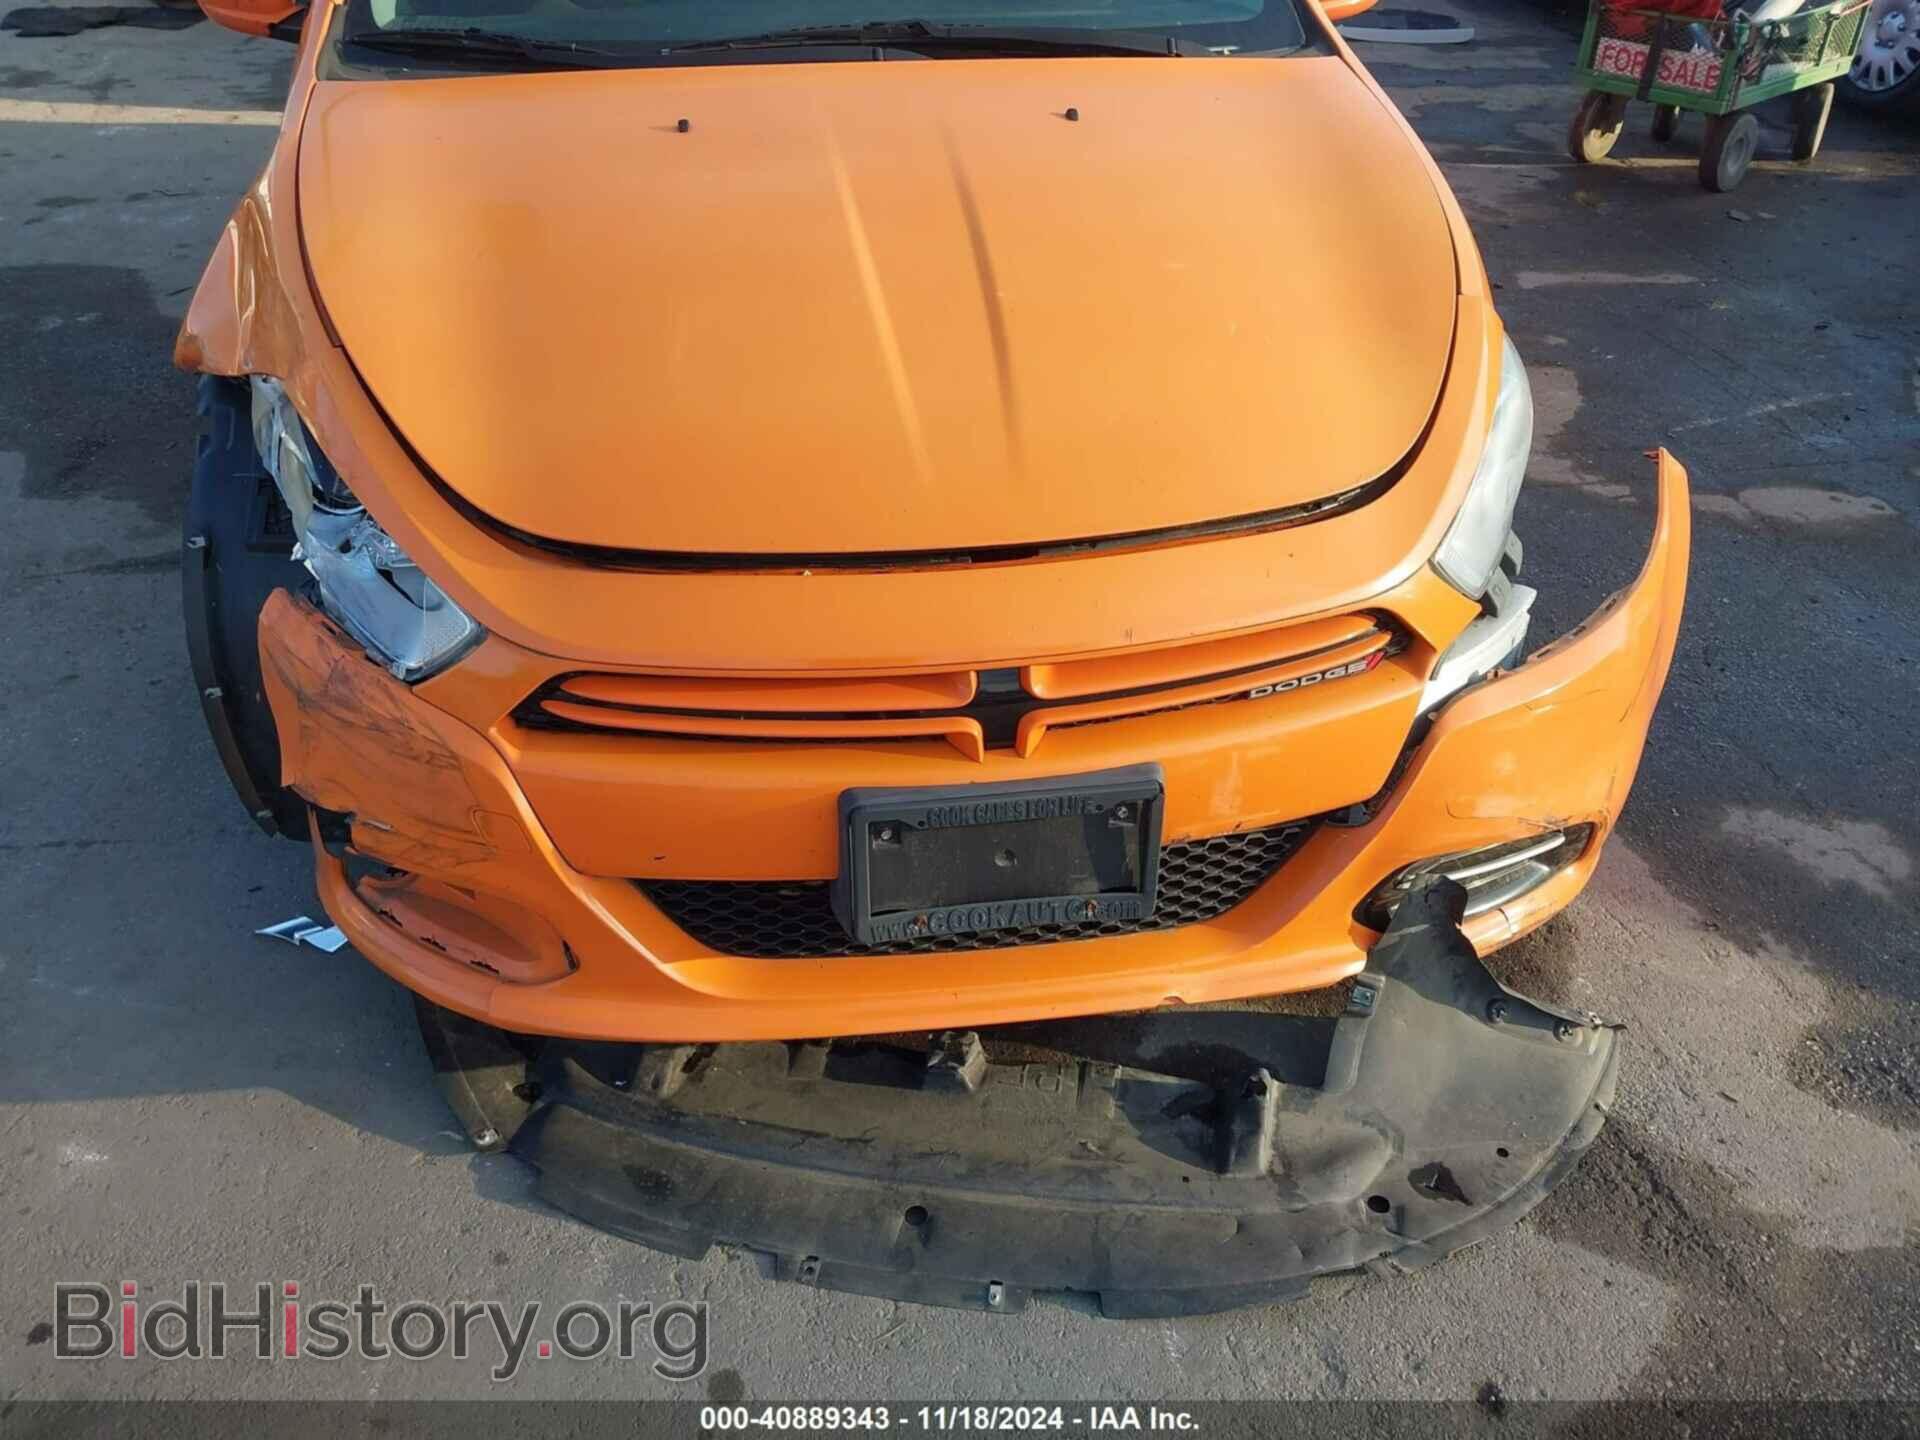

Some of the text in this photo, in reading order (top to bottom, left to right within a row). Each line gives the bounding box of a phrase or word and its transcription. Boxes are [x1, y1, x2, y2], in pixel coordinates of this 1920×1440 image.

[1601, 43, 1720, 90] FOR SALE
[1249, 659, 1368, 699] DODGE
